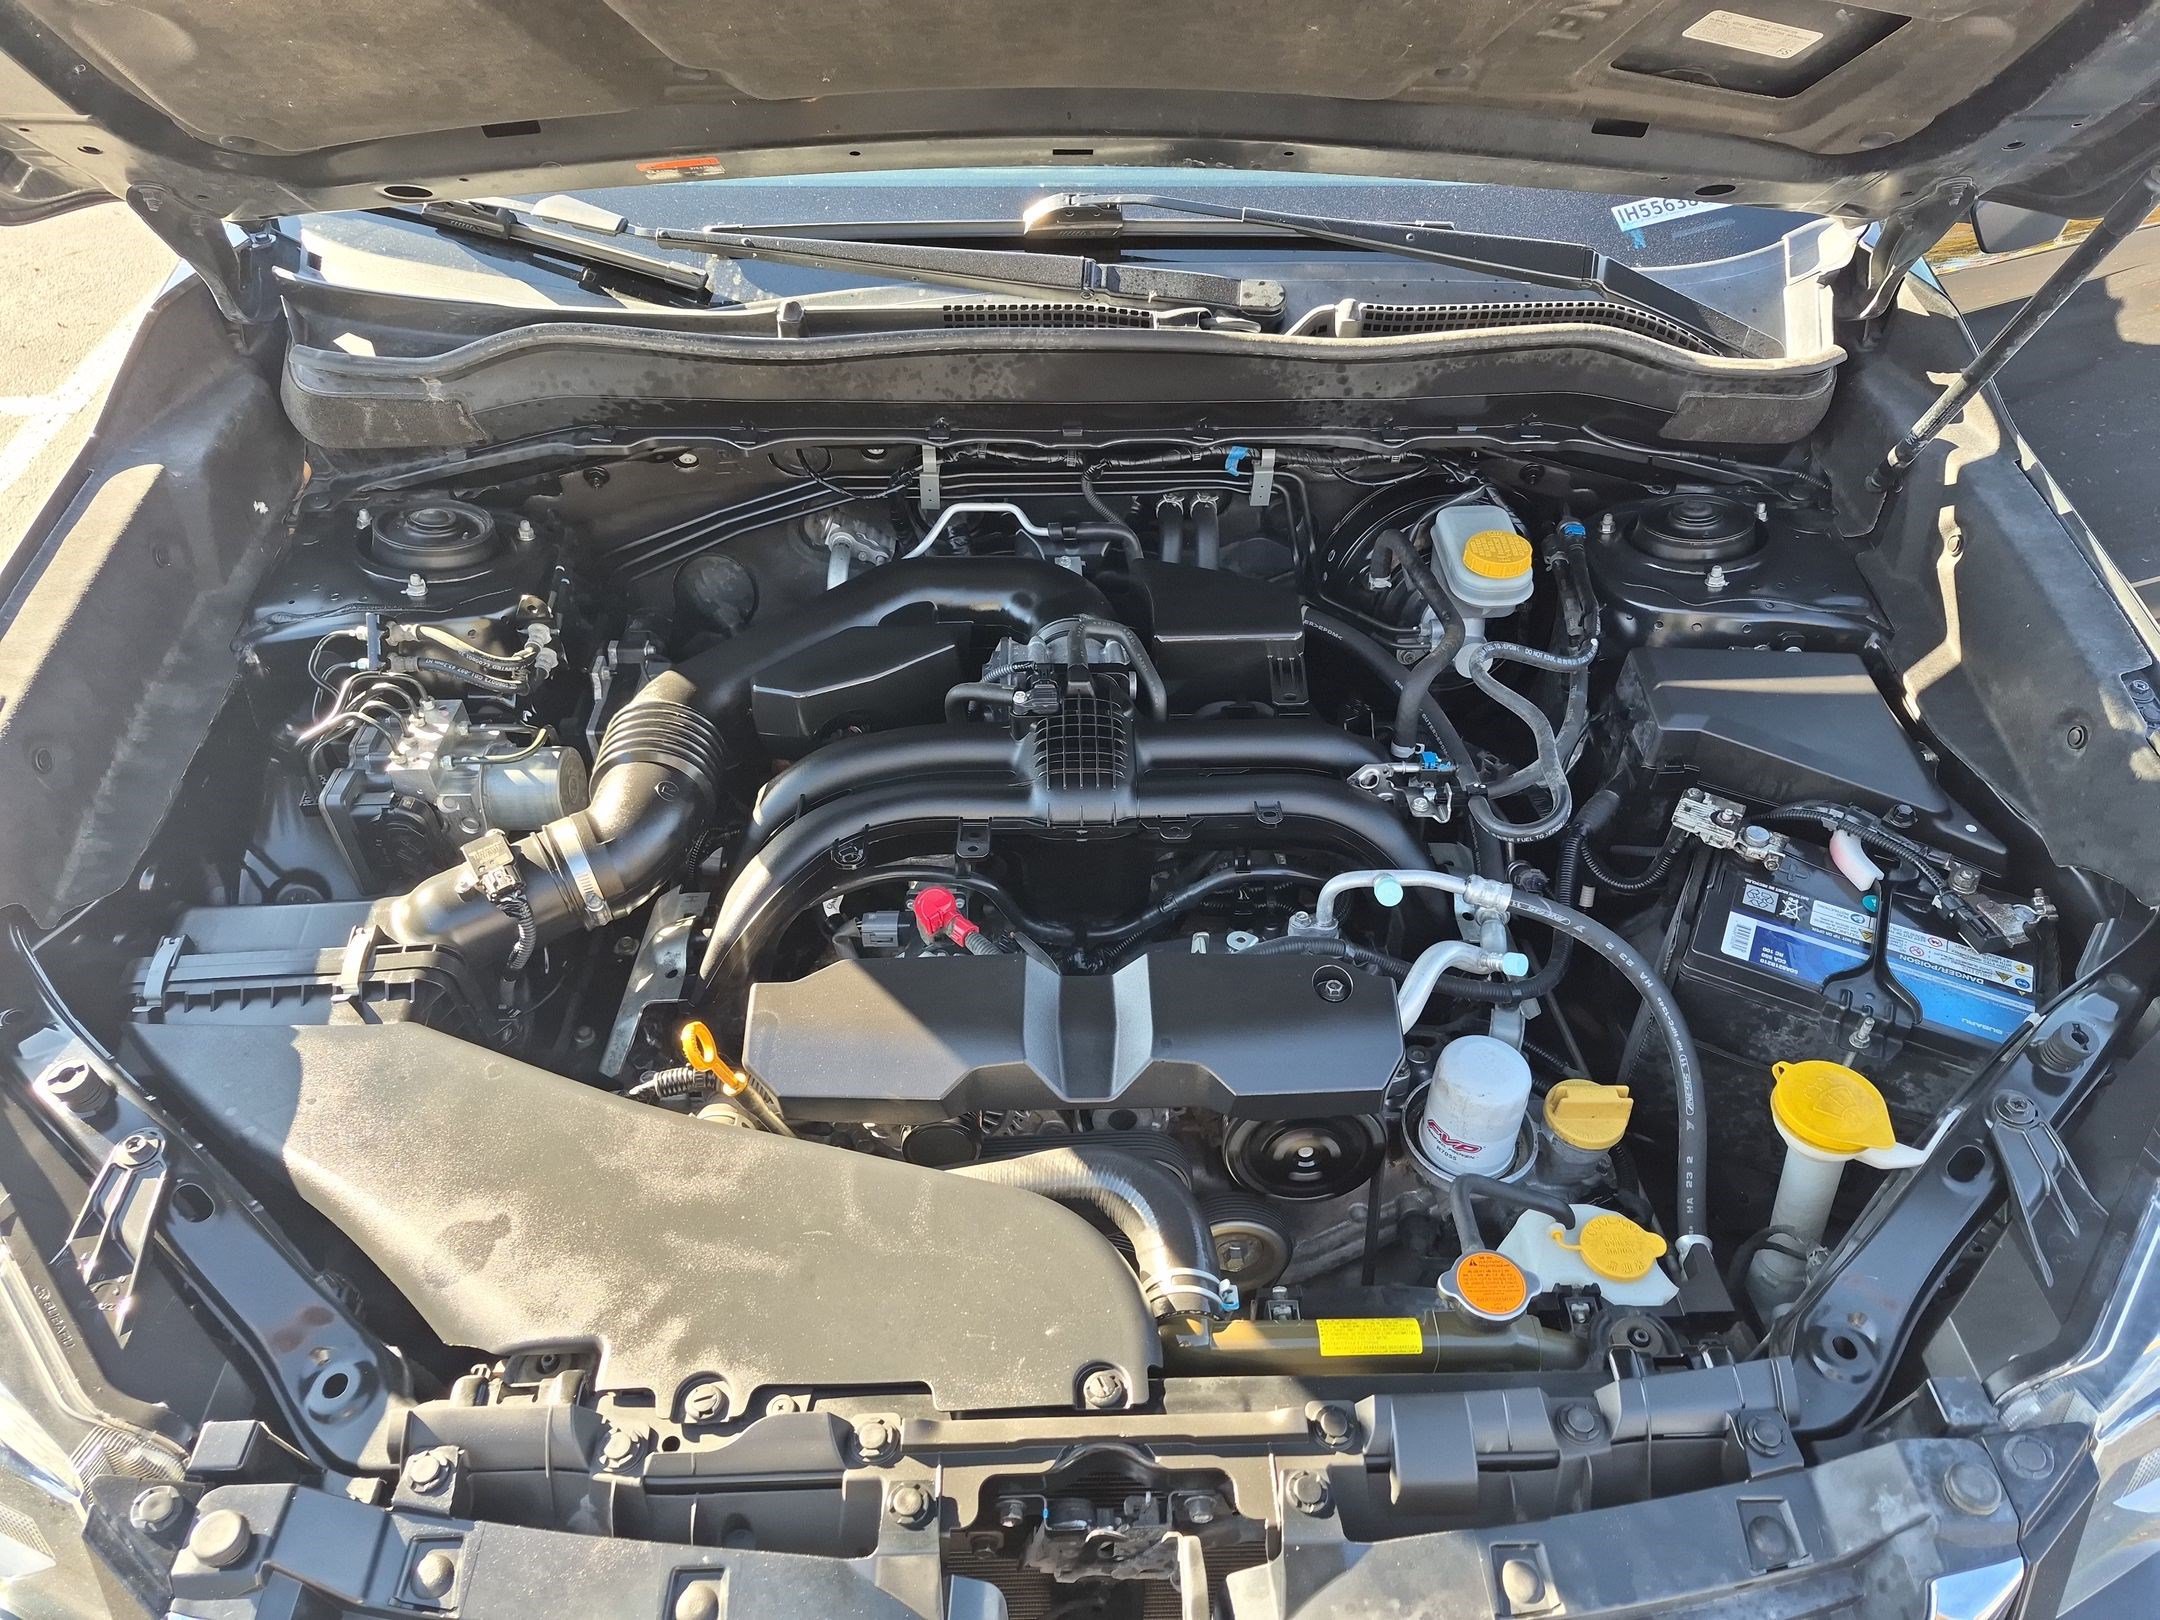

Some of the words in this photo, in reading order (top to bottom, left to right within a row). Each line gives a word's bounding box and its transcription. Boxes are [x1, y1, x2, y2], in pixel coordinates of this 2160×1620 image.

[1619, 953, 1635, 967] 23
[1898, 954, 1985, 985] DANGER/POISON
[1640, 972, 1654, 988] HA
[1961, 1018, 2003, 1035] SUBARU
[1686, 1172, 1693, 1188] 23
